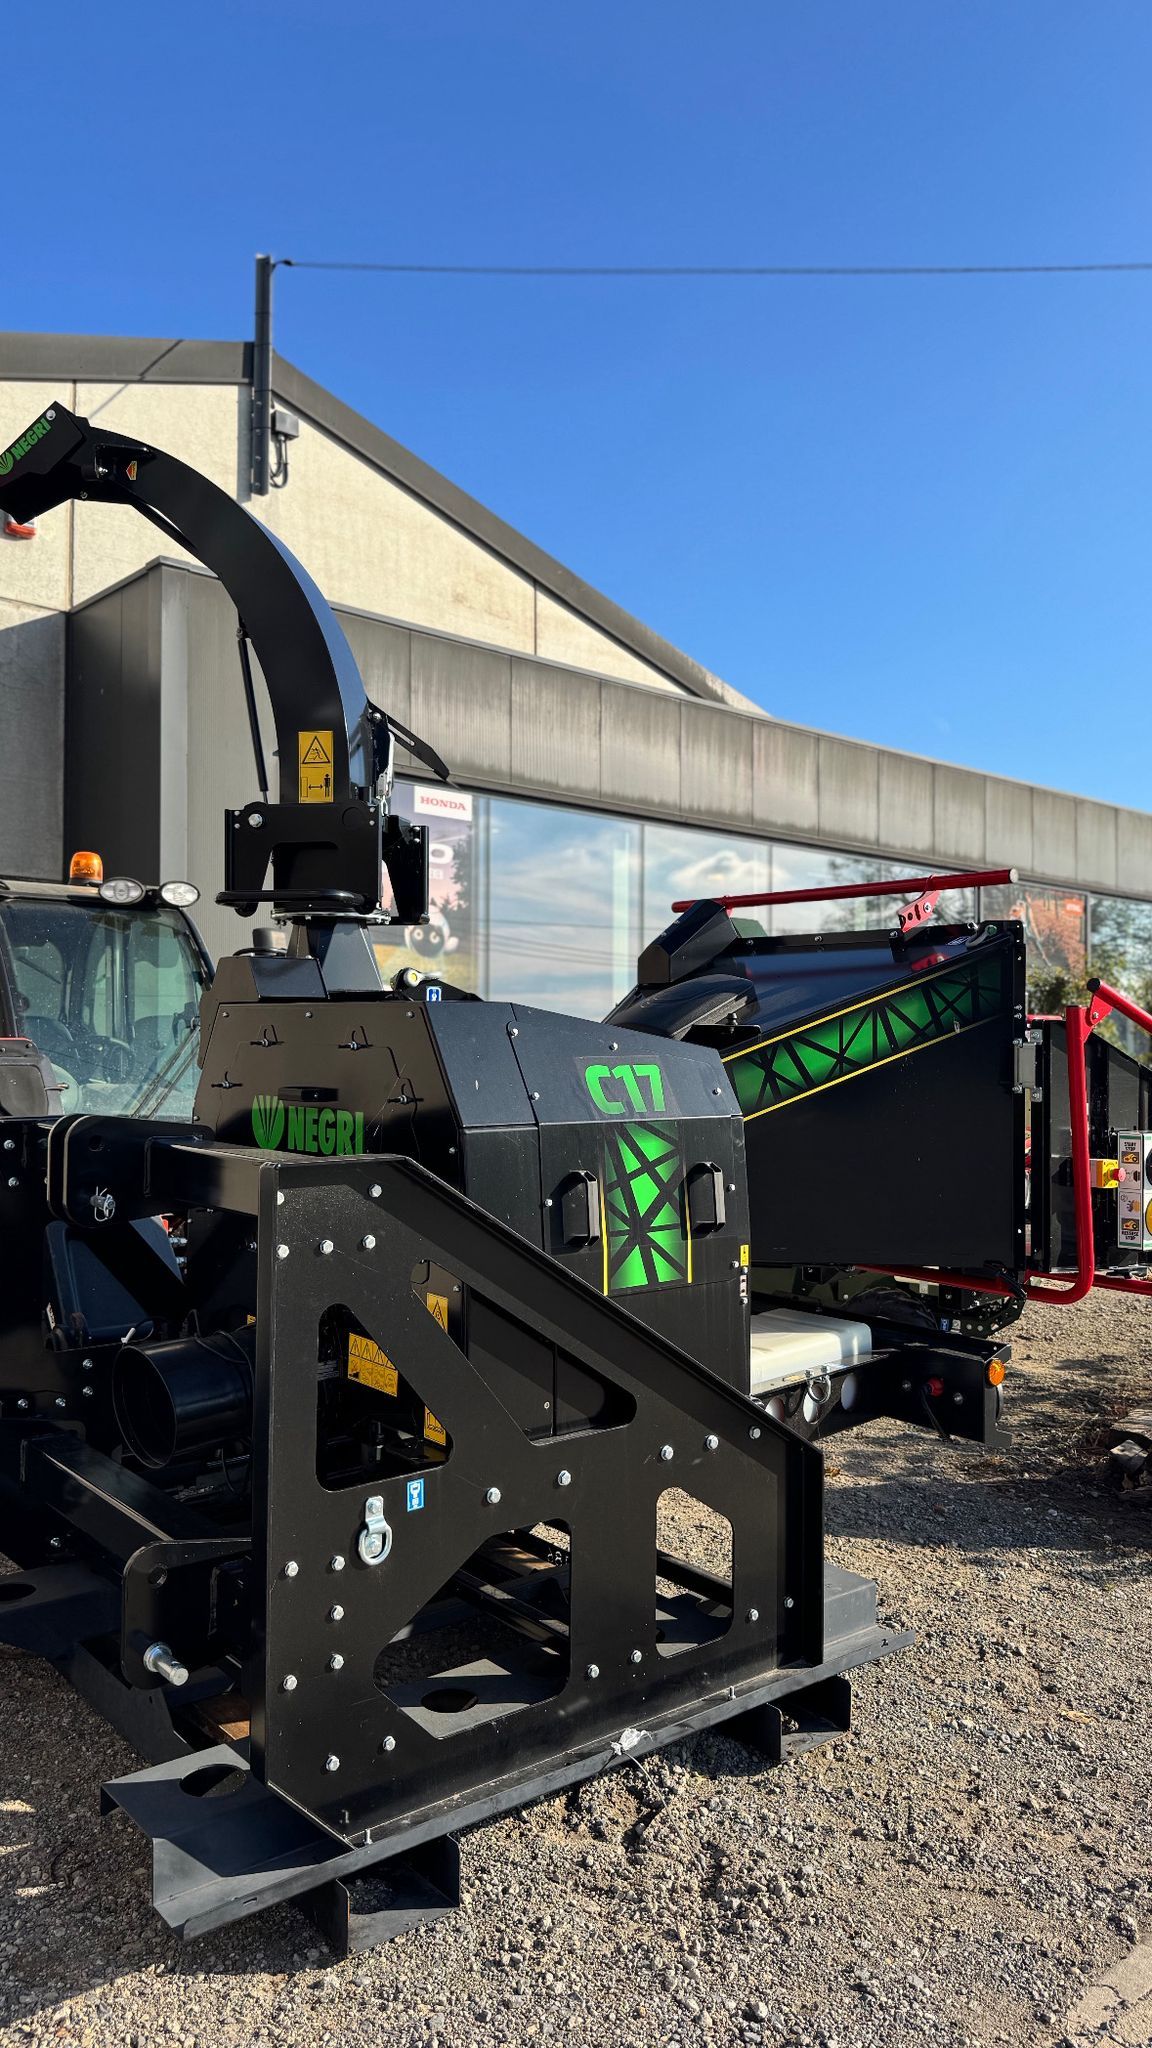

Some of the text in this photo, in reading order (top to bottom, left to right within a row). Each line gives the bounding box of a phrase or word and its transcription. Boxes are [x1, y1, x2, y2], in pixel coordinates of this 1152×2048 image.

[10, 417, 52, 461] NEGRI
[420, 796, 466, 811] HONDA
[585, 1064, 666, 1115] C17
[287, 1105, 364, 1156] NEGRI
